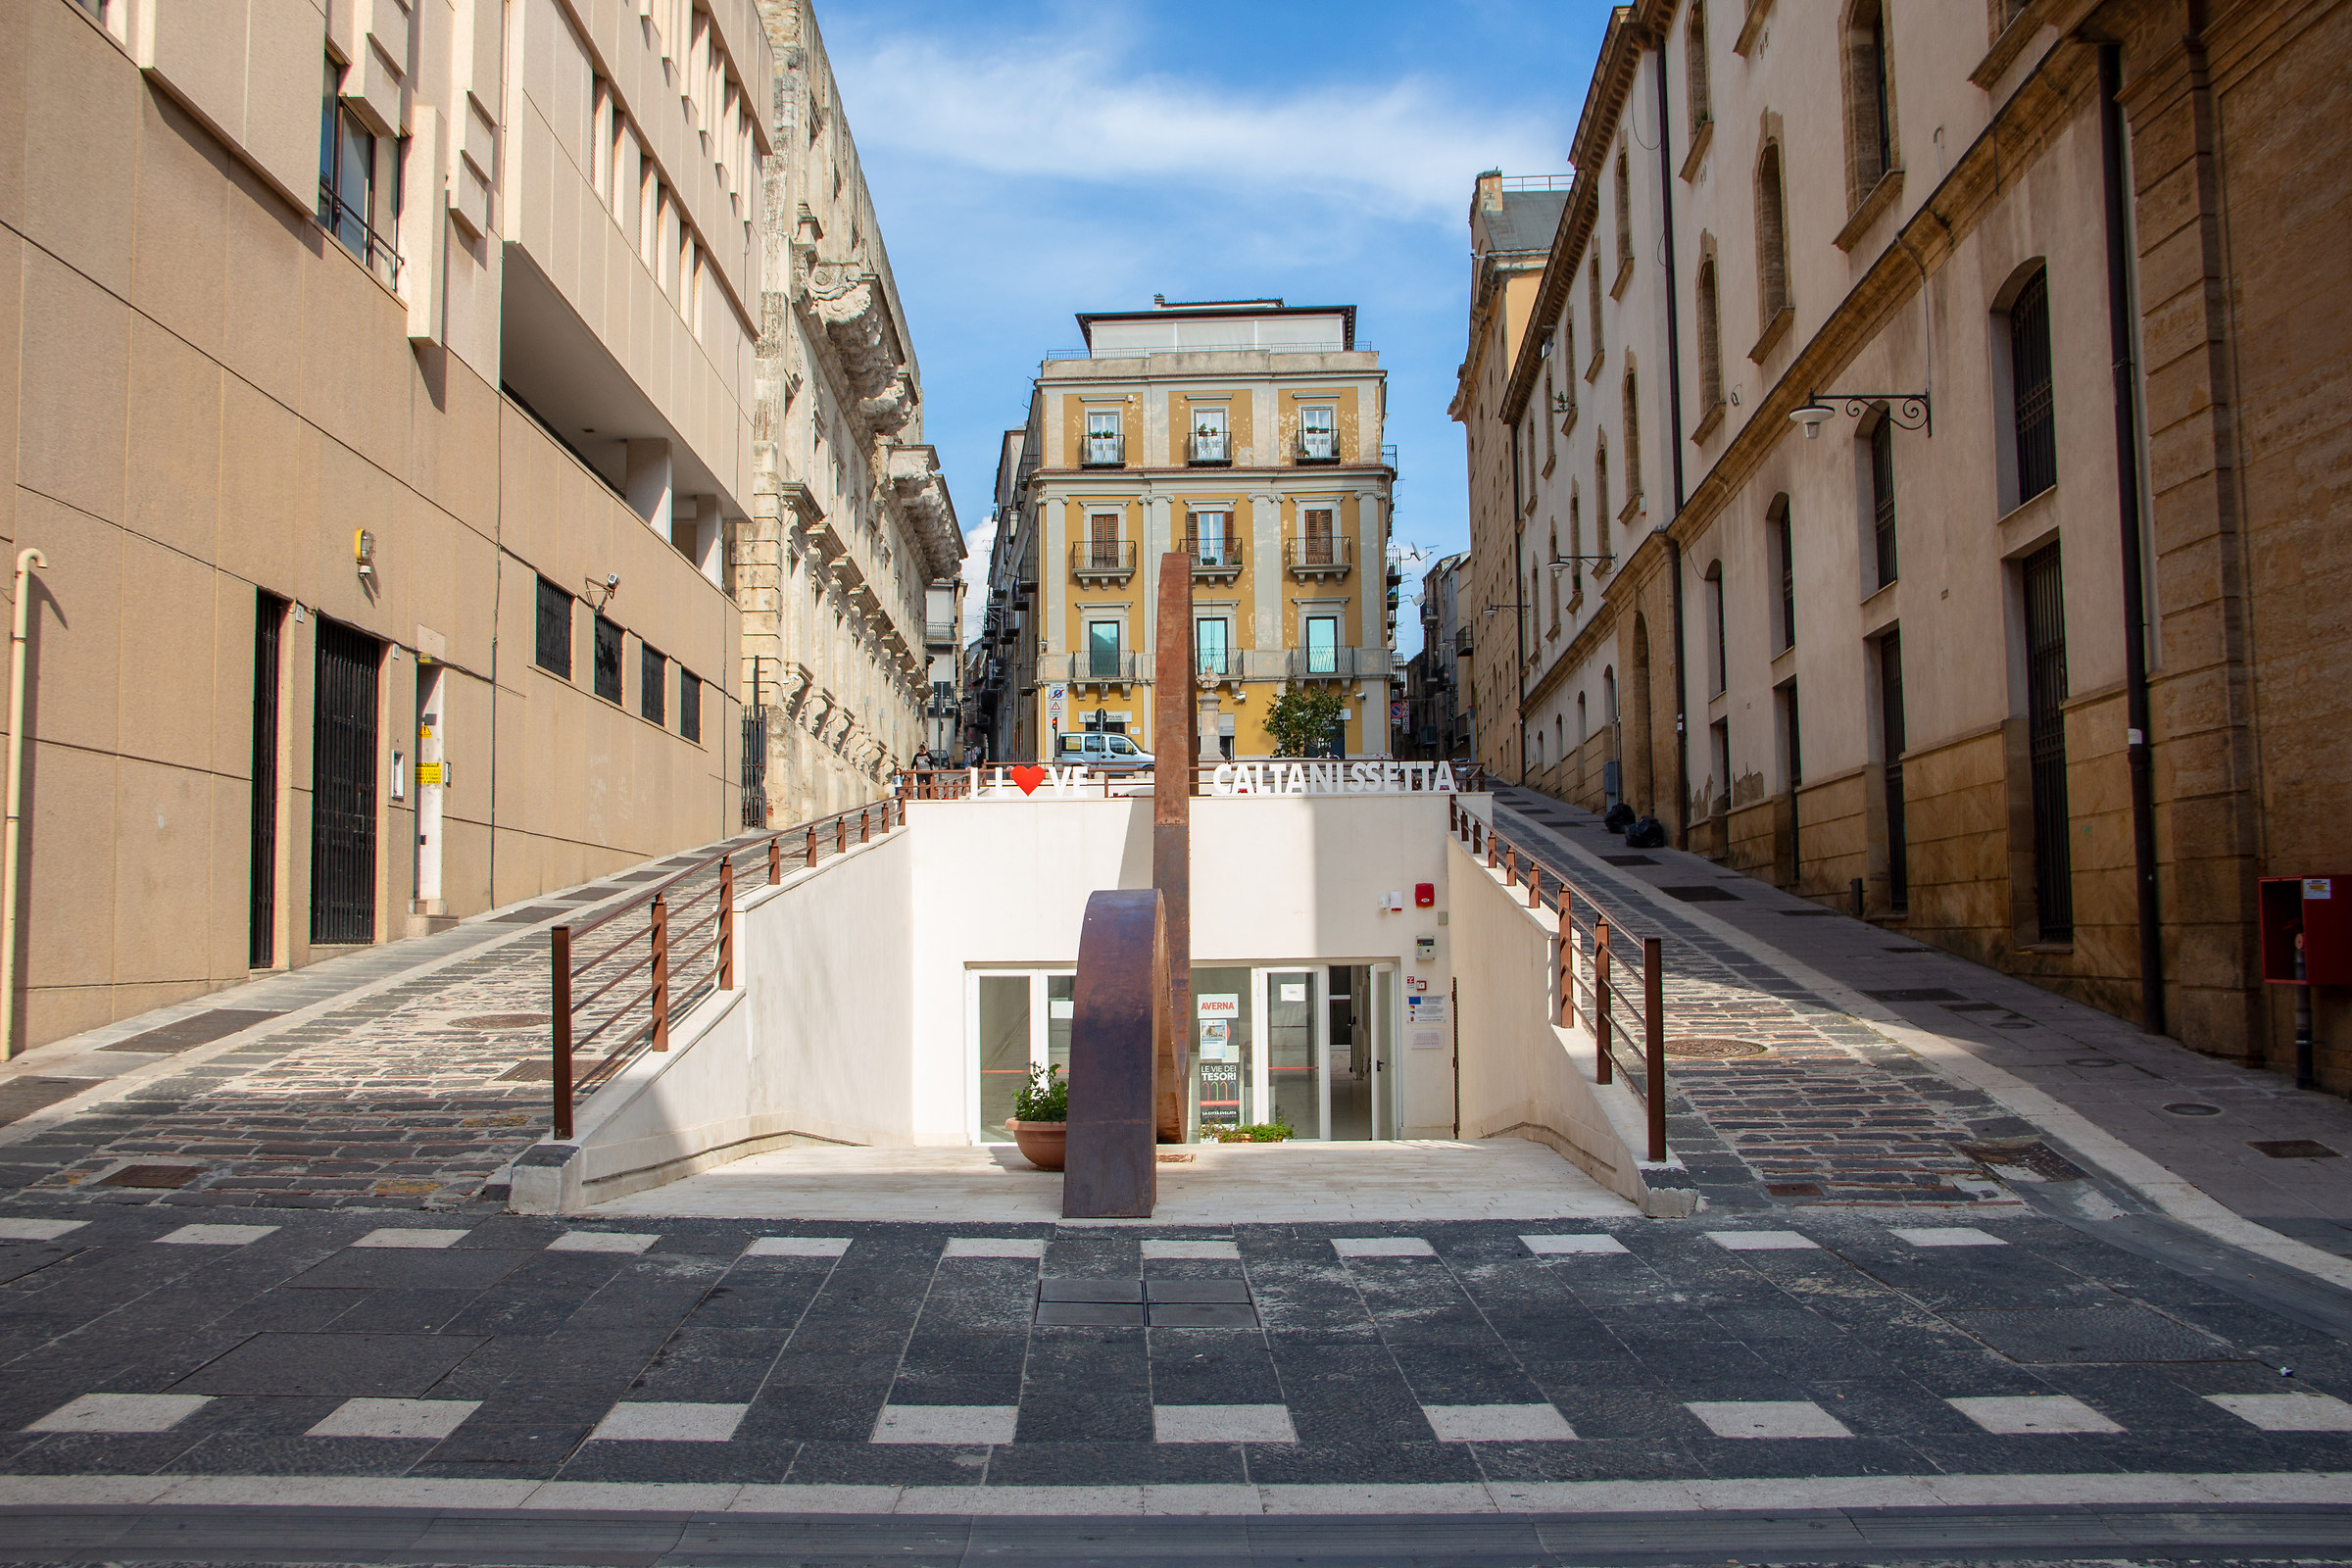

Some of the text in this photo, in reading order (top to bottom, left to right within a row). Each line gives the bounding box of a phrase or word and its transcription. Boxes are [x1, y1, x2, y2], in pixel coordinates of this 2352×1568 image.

[970, 767, 978, 799] I
[1212, 760, 1457, 794] CALTANISSETTA
[1200, 1002, 1235, 1010] AVERNA
[1201, 1072, 1237, 1081] TESORI
